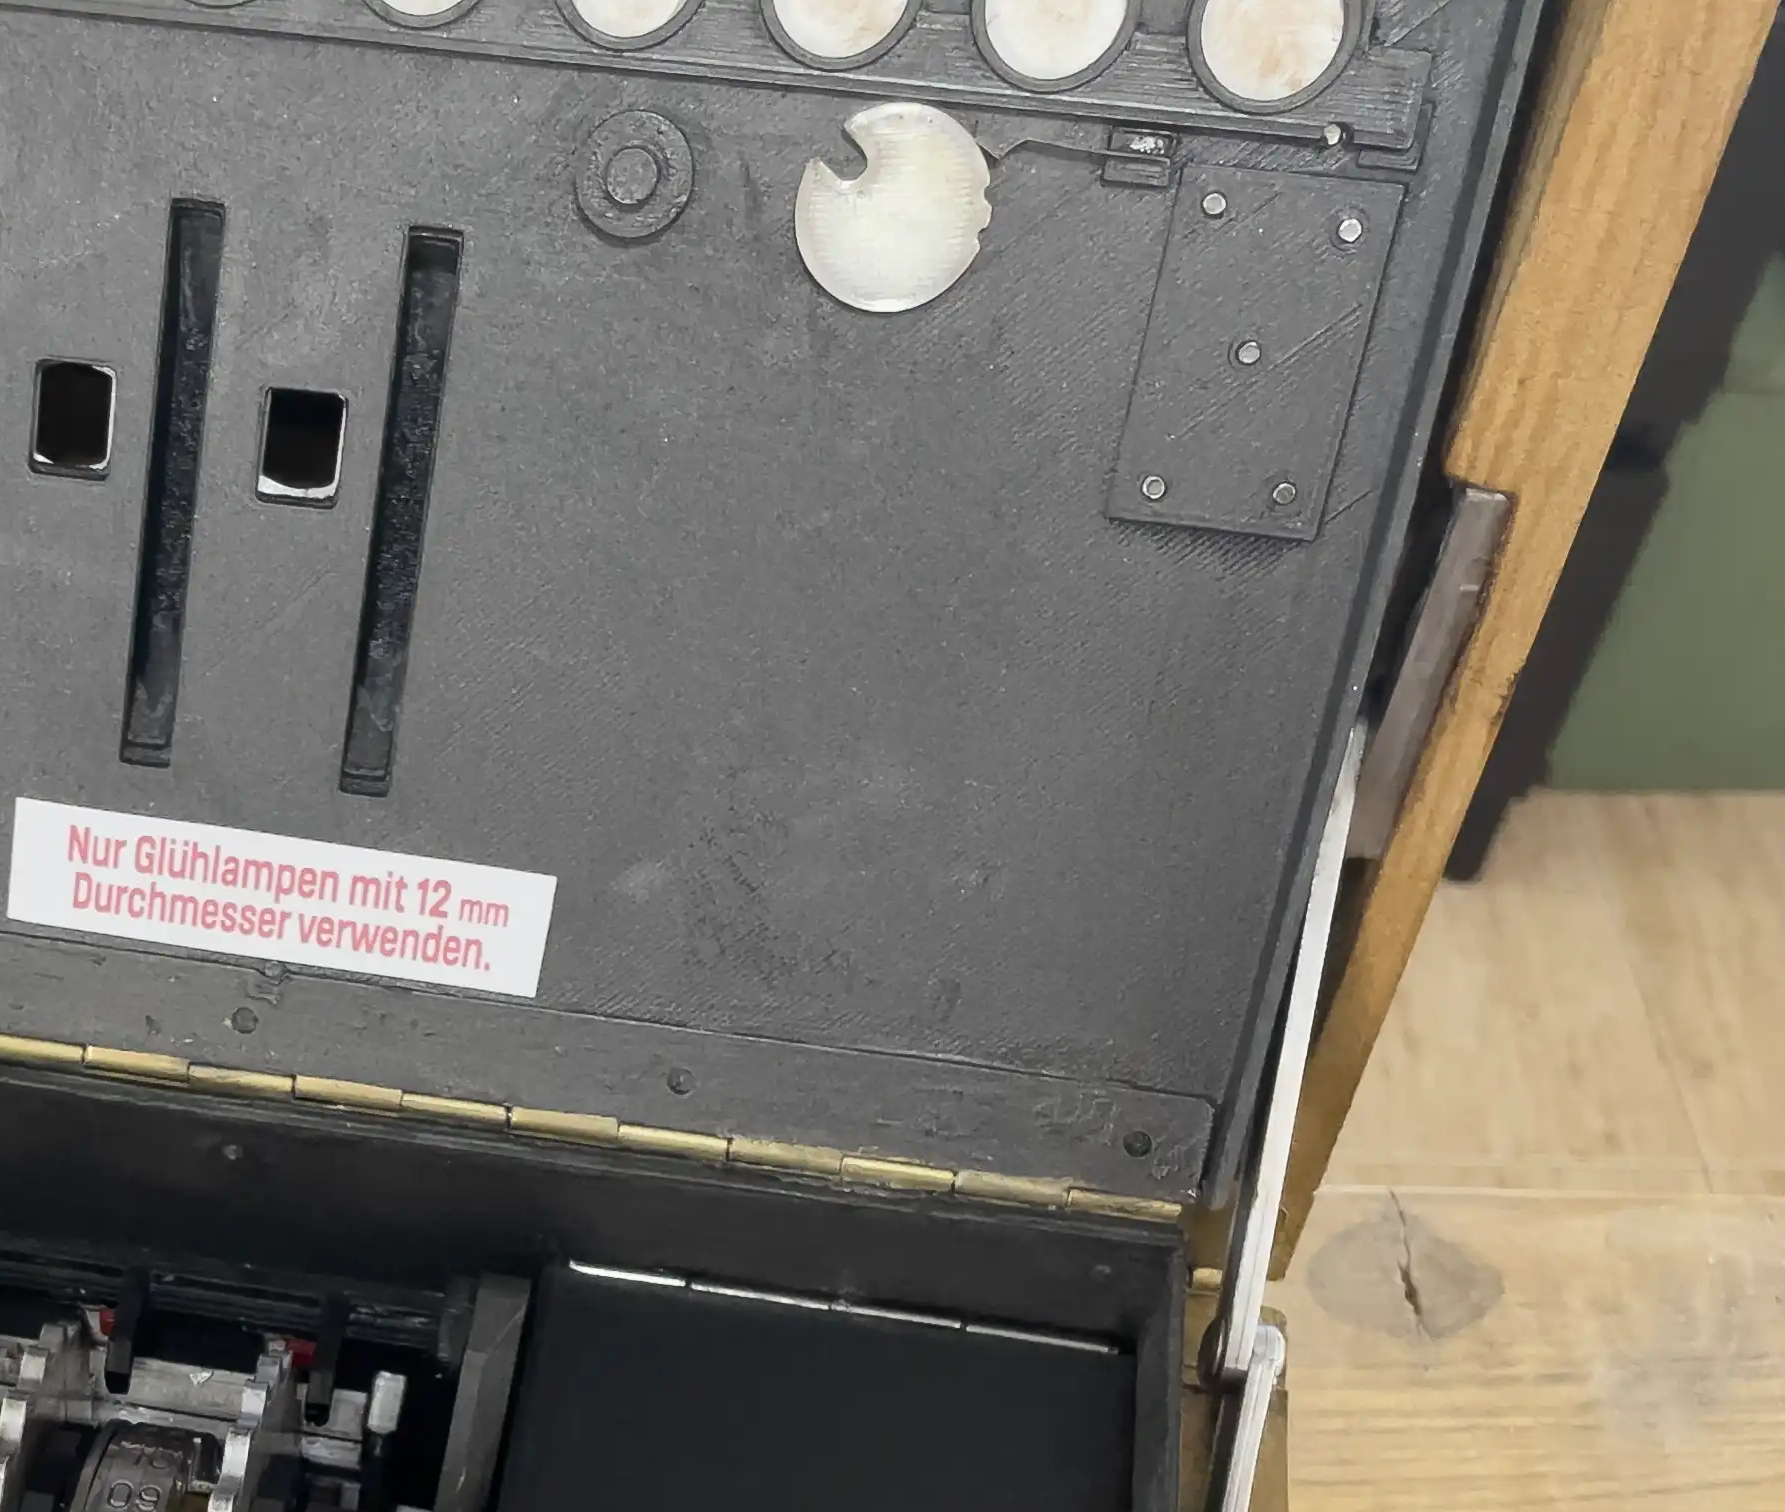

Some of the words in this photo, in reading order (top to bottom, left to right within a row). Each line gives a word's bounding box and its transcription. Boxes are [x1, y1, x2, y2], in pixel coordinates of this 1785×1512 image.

[67, 824, 128, 869] Nur
[134, 834, 339, 904] Glühlampen
[349, 873, 409, 914] mit
[415, 878, 452, 919] 12
[458, 895, 510, 928] mm
[71, 871, 293, 942] Durchmesser
[297, 913, 492, 971] verwenden.
